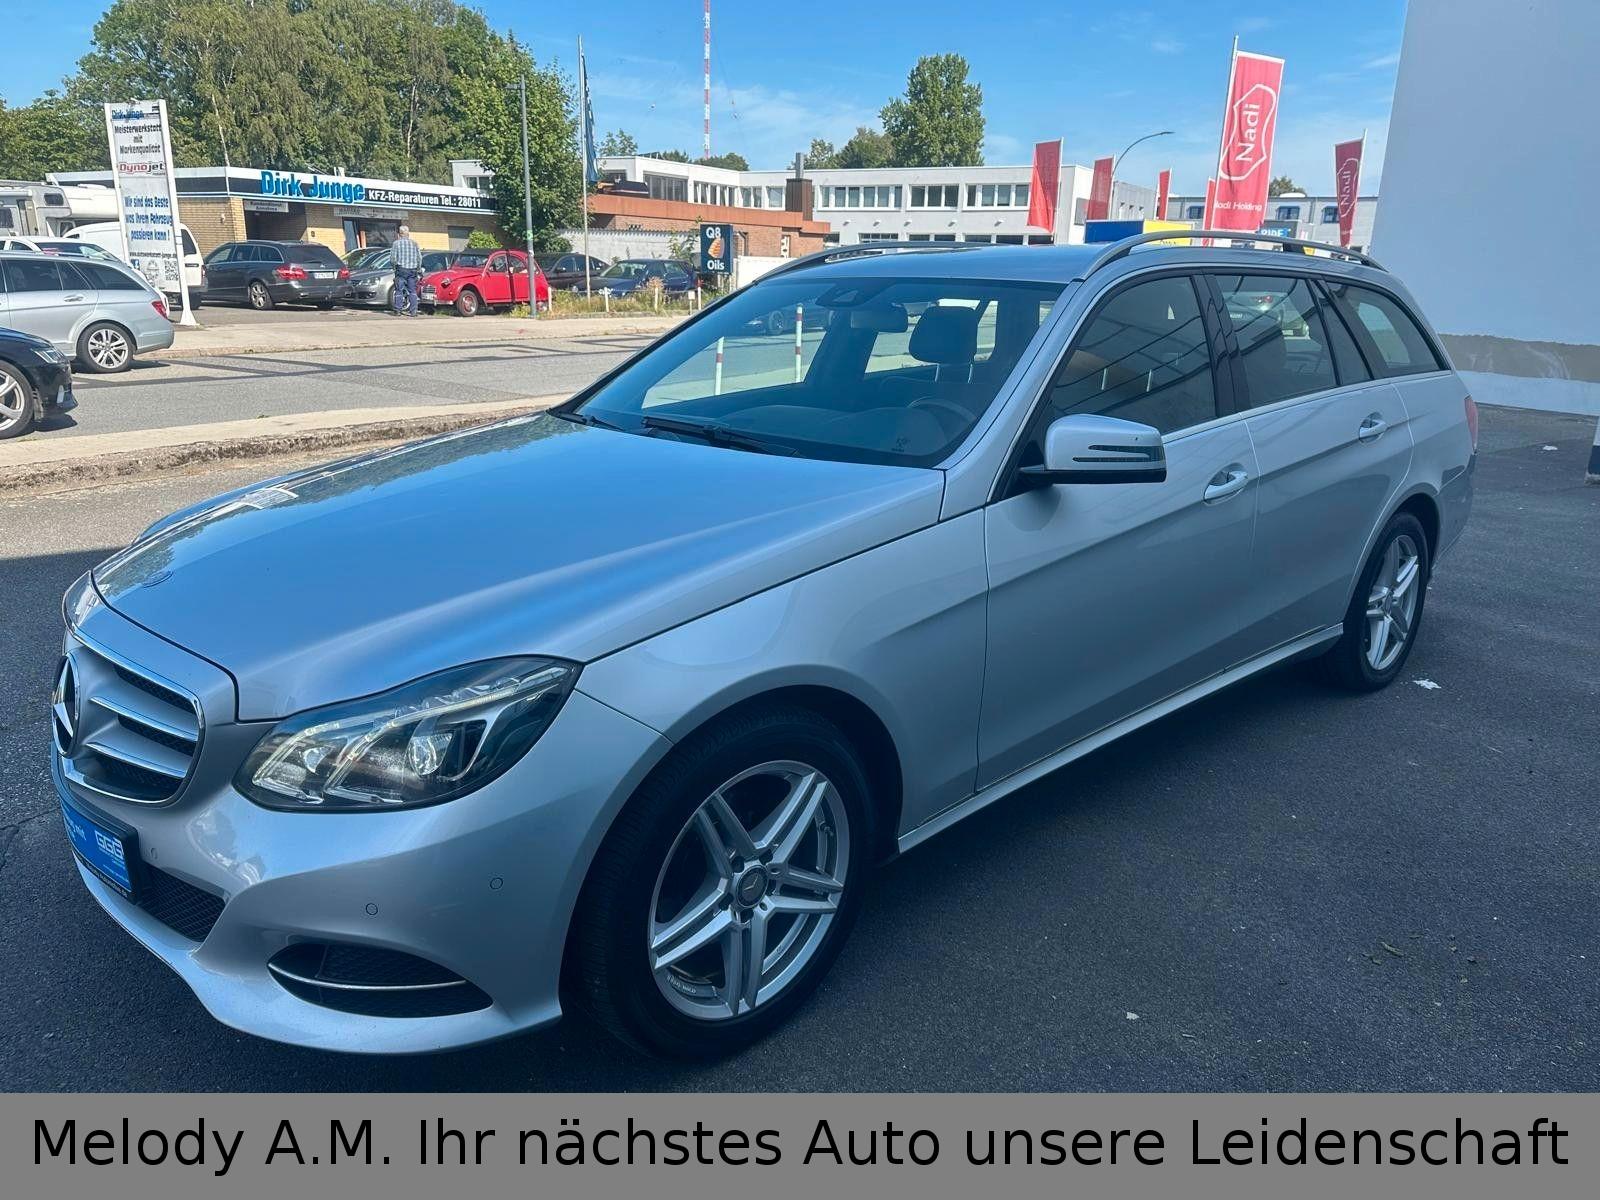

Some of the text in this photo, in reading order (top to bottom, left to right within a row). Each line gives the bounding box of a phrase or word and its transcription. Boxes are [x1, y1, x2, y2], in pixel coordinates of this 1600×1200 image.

[1235, 104, 1260, 161] Nadi
[120, 163, 163, 172] Dynojet
[261, 171, 365, 204] Dirk Junge
[368, 189, 481, 208] KFZ-Reparaturen Tel.: 28011
[1233, 201, 1262, 211] Holding
[706, 227, 721, 238] Q8
[707, 260, 725, 270] Oils
